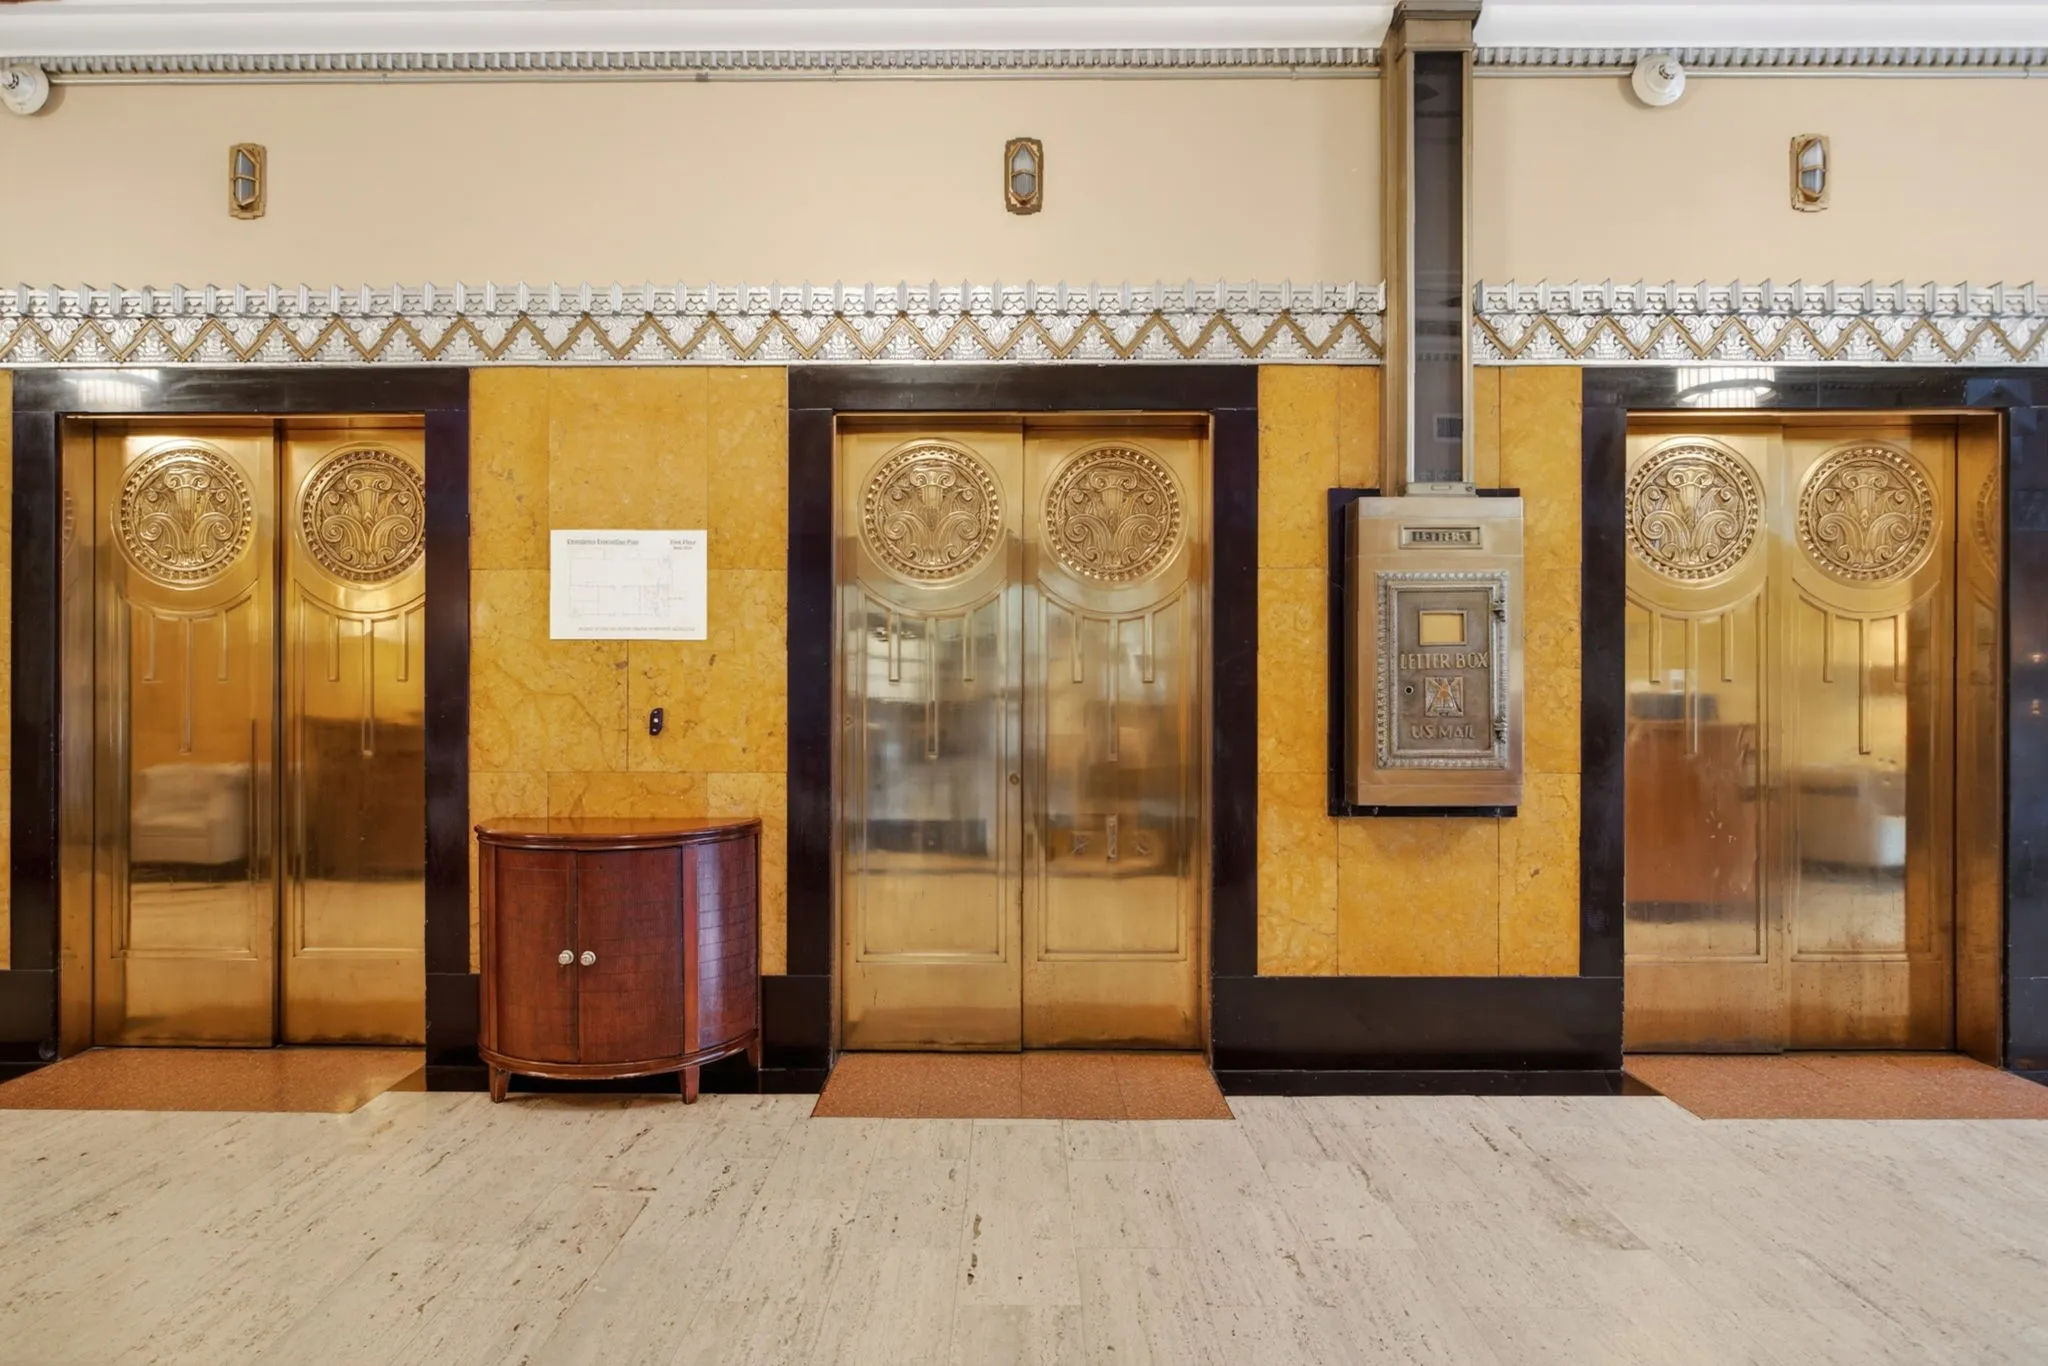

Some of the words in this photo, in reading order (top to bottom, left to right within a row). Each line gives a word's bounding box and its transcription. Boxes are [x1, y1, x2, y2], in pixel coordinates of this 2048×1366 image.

[1400, 653, 1450, 669] LETTER
[1455, 652, 1488, 669] BOX
[1438, 725, 1476, 739] MAIL
